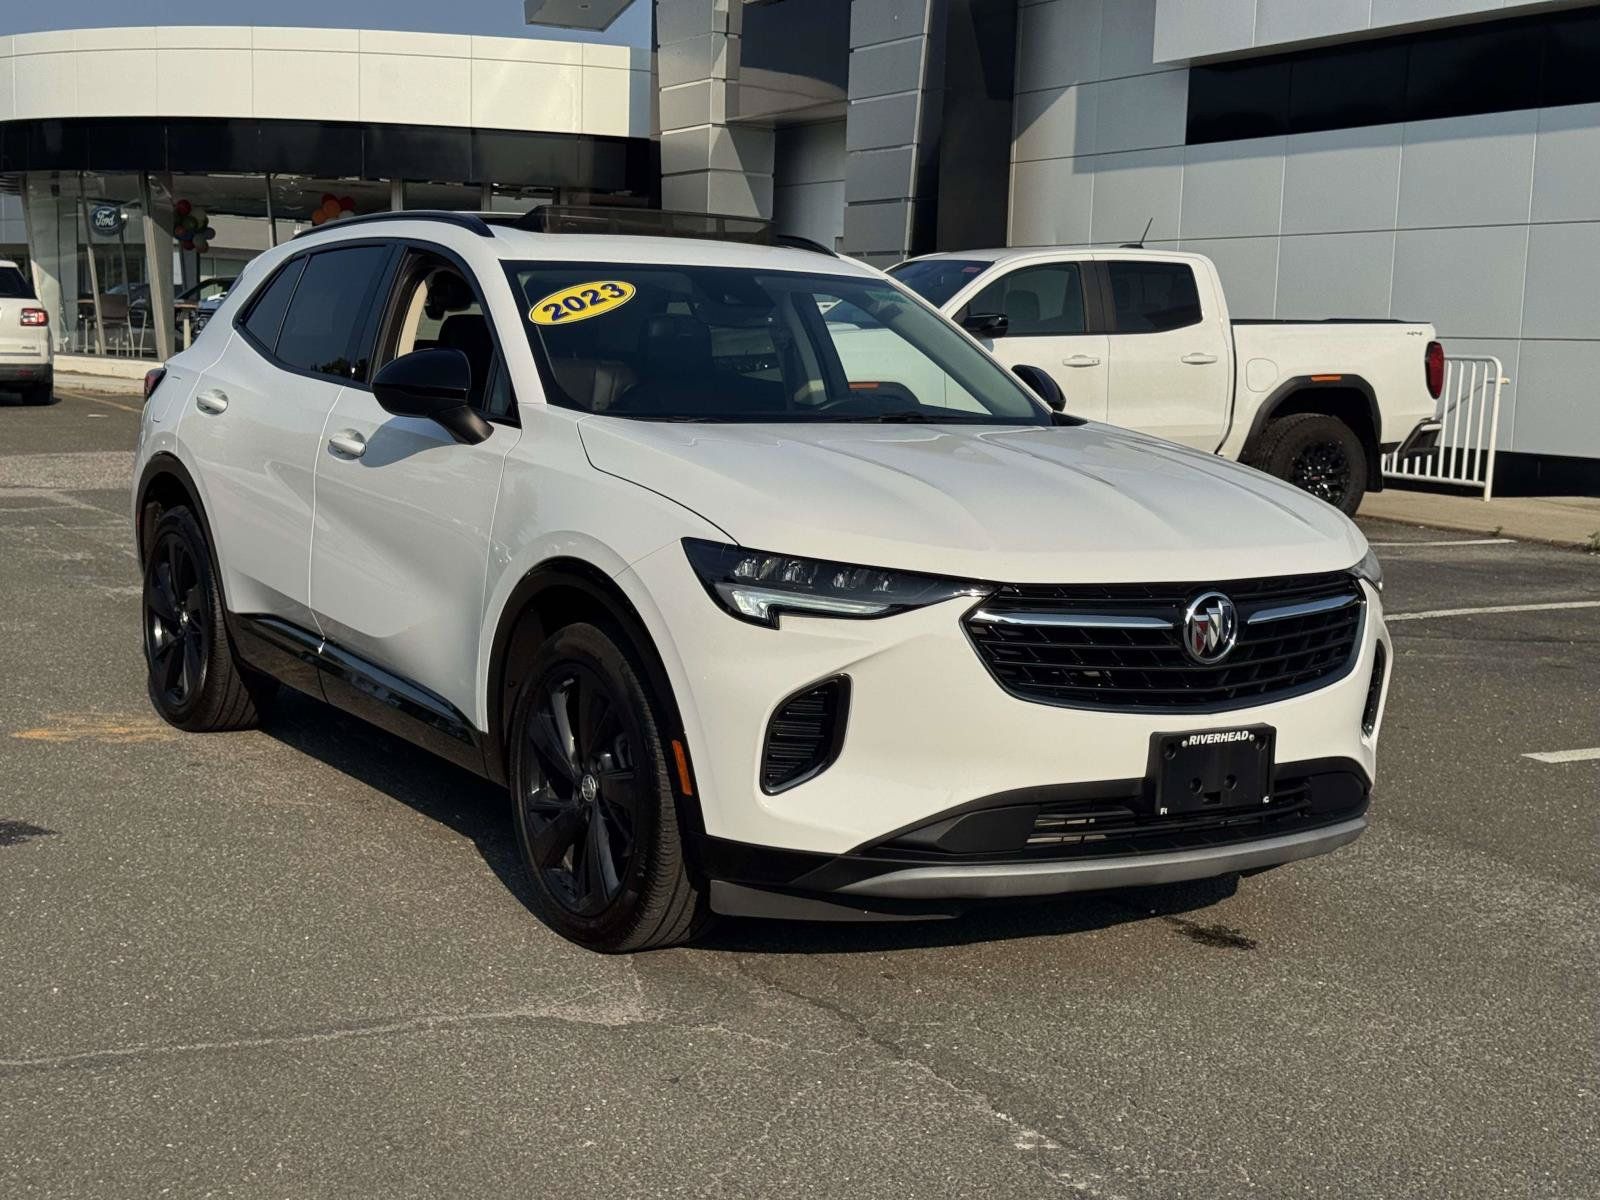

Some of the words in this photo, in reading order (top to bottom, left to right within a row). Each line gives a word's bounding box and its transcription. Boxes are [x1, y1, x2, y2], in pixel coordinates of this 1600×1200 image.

[95, 210, 115, 226] Ford
[542, 283, 626, 321] 2023
[1188, 730, 1249, 746] RIVERHEAD
